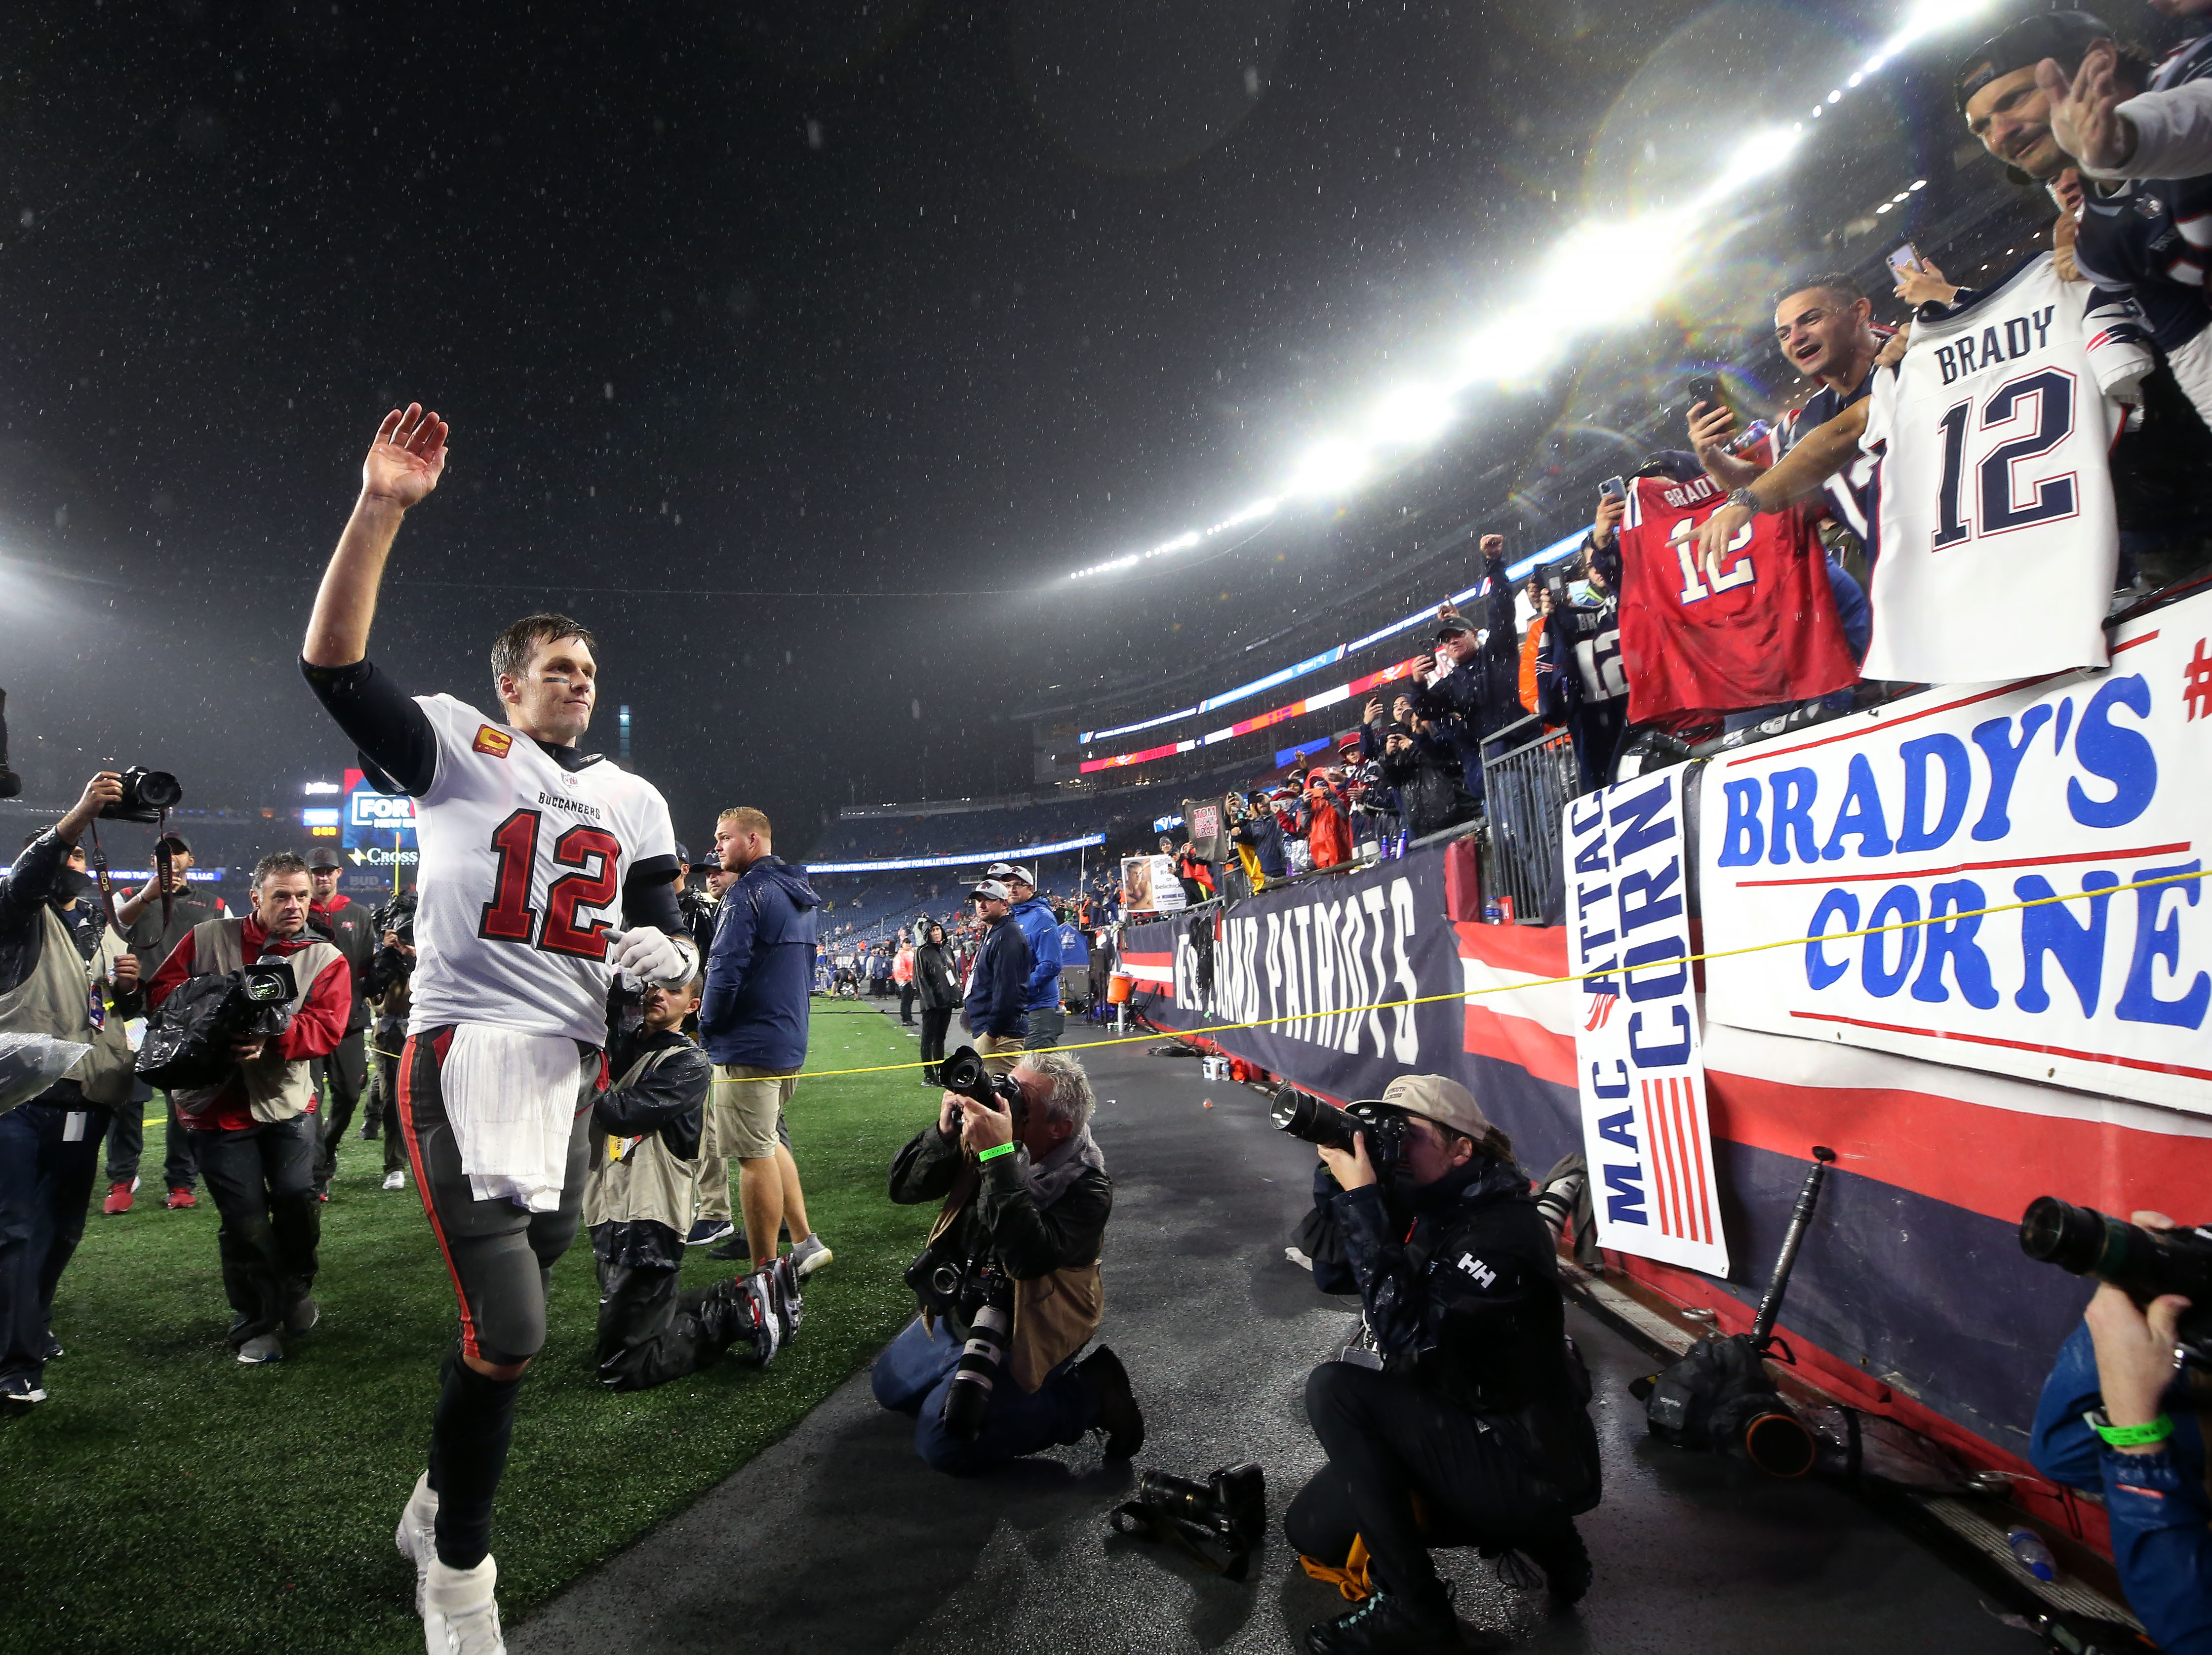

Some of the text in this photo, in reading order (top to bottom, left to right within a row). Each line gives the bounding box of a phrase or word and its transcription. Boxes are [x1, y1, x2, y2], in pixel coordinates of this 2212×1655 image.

[1934, 305, 2056, 386] BRADY
[1932, 366, 2080, 552] 12
[1669, 503, 1757, 605] 12
[1575, 629, 1630, 703] 12
[479, 727, 511, 750] C
[1718, 673, 2157, 868] BRADY'S
[538, 791, 600, 820] BUCCANEERS
[1194, 806, 1217, 818] TOM
[100, 871, 109, 891] EOS
[349, 876, 379, 885] BUD
[477, 807, 622, 964] 12
[806, 864, 833, 873] GROUND
[833, 862, 877, 872] MAINTENANCE
[878, 861, 911, 870] EQUIPMENT
[923, 857, 950, 867] GILLETTE
[950, 854, 974, 864] STADIUM
[980, 853, 1003, 861] SUPPLIED
[1033, 846, 1055, 855] COMPANY
[1609, 773, 1691, 1068] CORN
[1805, 858, 2212, 1030] CORNE
[1265, 877, 1420, 1065] PATRIOTS
[1592, 1059, 1649, 1226] MAC
[1457, 1252, 1497, 1288] HH
